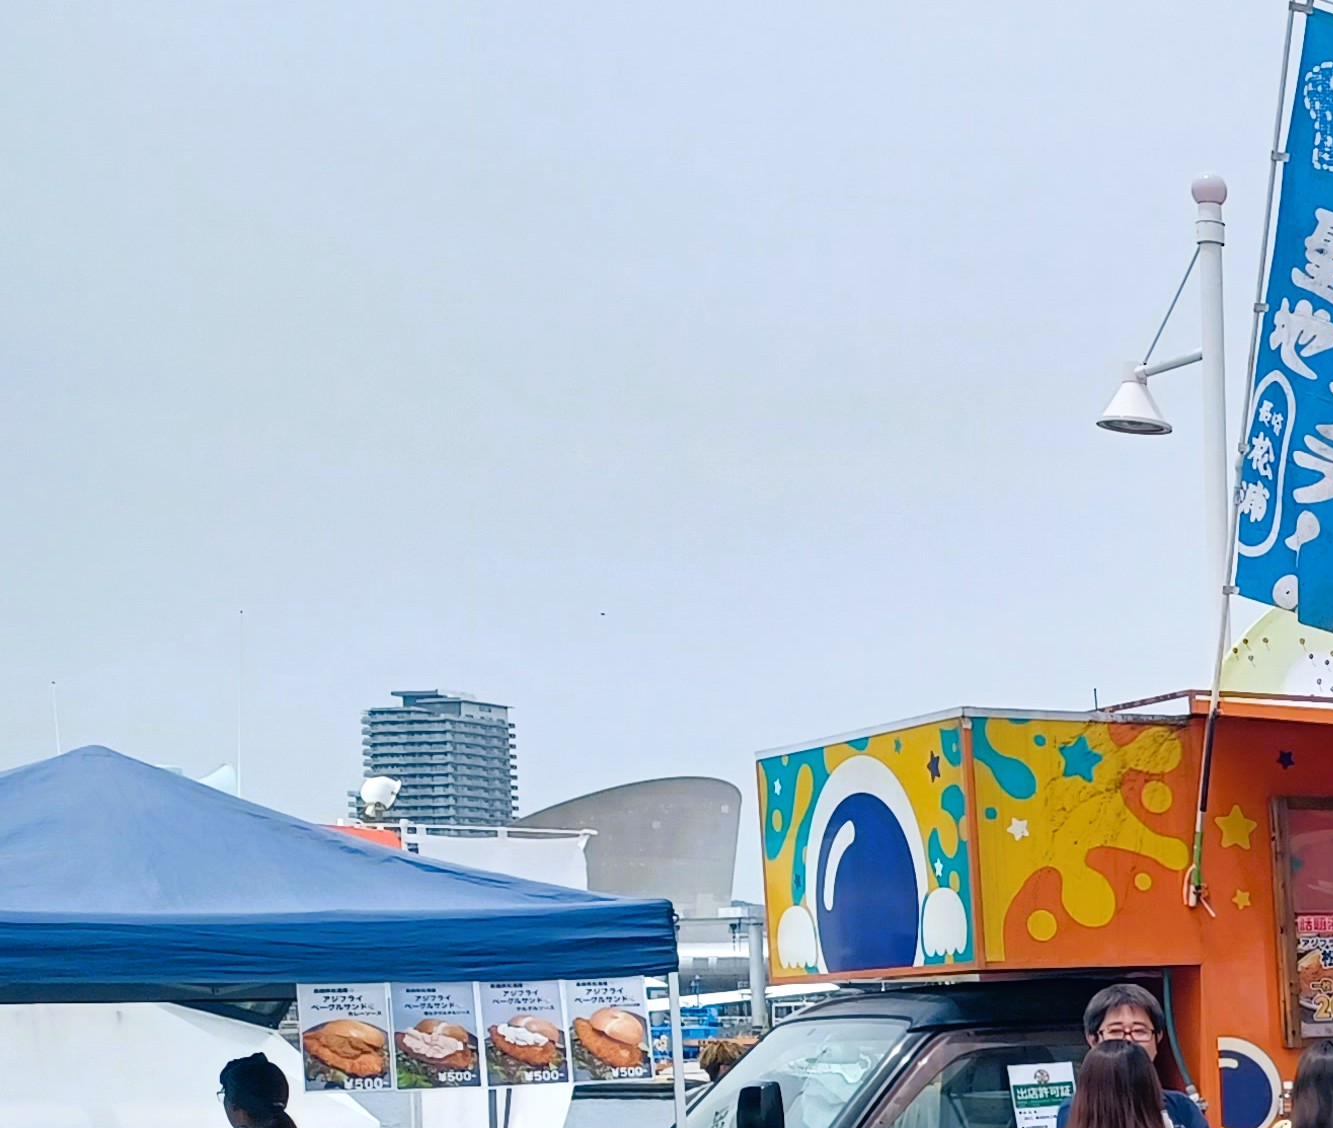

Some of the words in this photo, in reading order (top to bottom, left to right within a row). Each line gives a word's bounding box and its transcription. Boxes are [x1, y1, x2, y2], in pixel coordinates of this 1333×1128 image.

[503, 989, 539, 997] アジフライ
[585, 987, 624, 996] アジフライ
[492, 997, 543, 1005] ベーグルサンド
[574, 995, 630, 1004] ベーグルサンド
[311, 1002, 369, 1011] ベーグルサンド
[405, 1001, 456, 1010] ベーグルサンド
